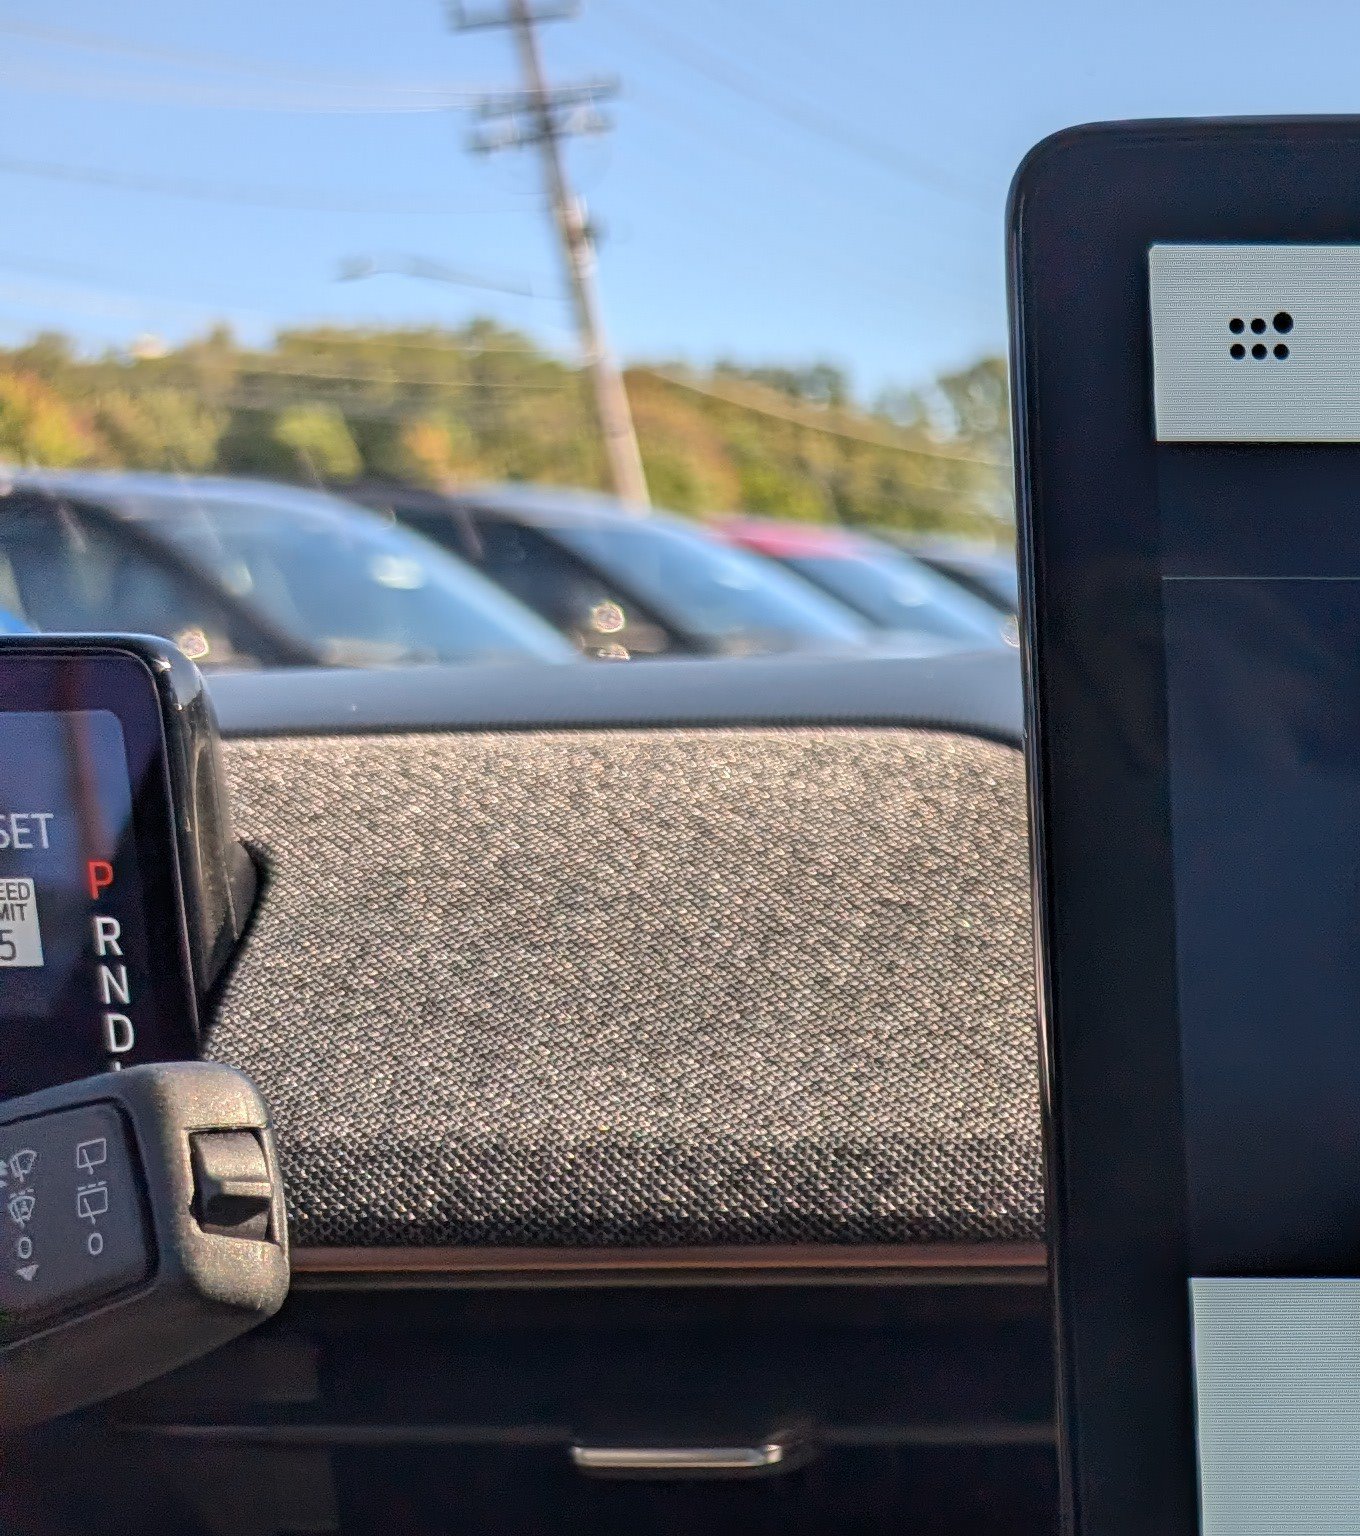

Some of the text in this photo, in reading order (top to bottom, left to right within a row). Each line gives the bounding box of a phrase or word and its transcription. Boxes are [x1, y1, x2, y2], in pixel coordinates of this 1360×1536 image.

[87, 860, 135, 1053] P R N D
